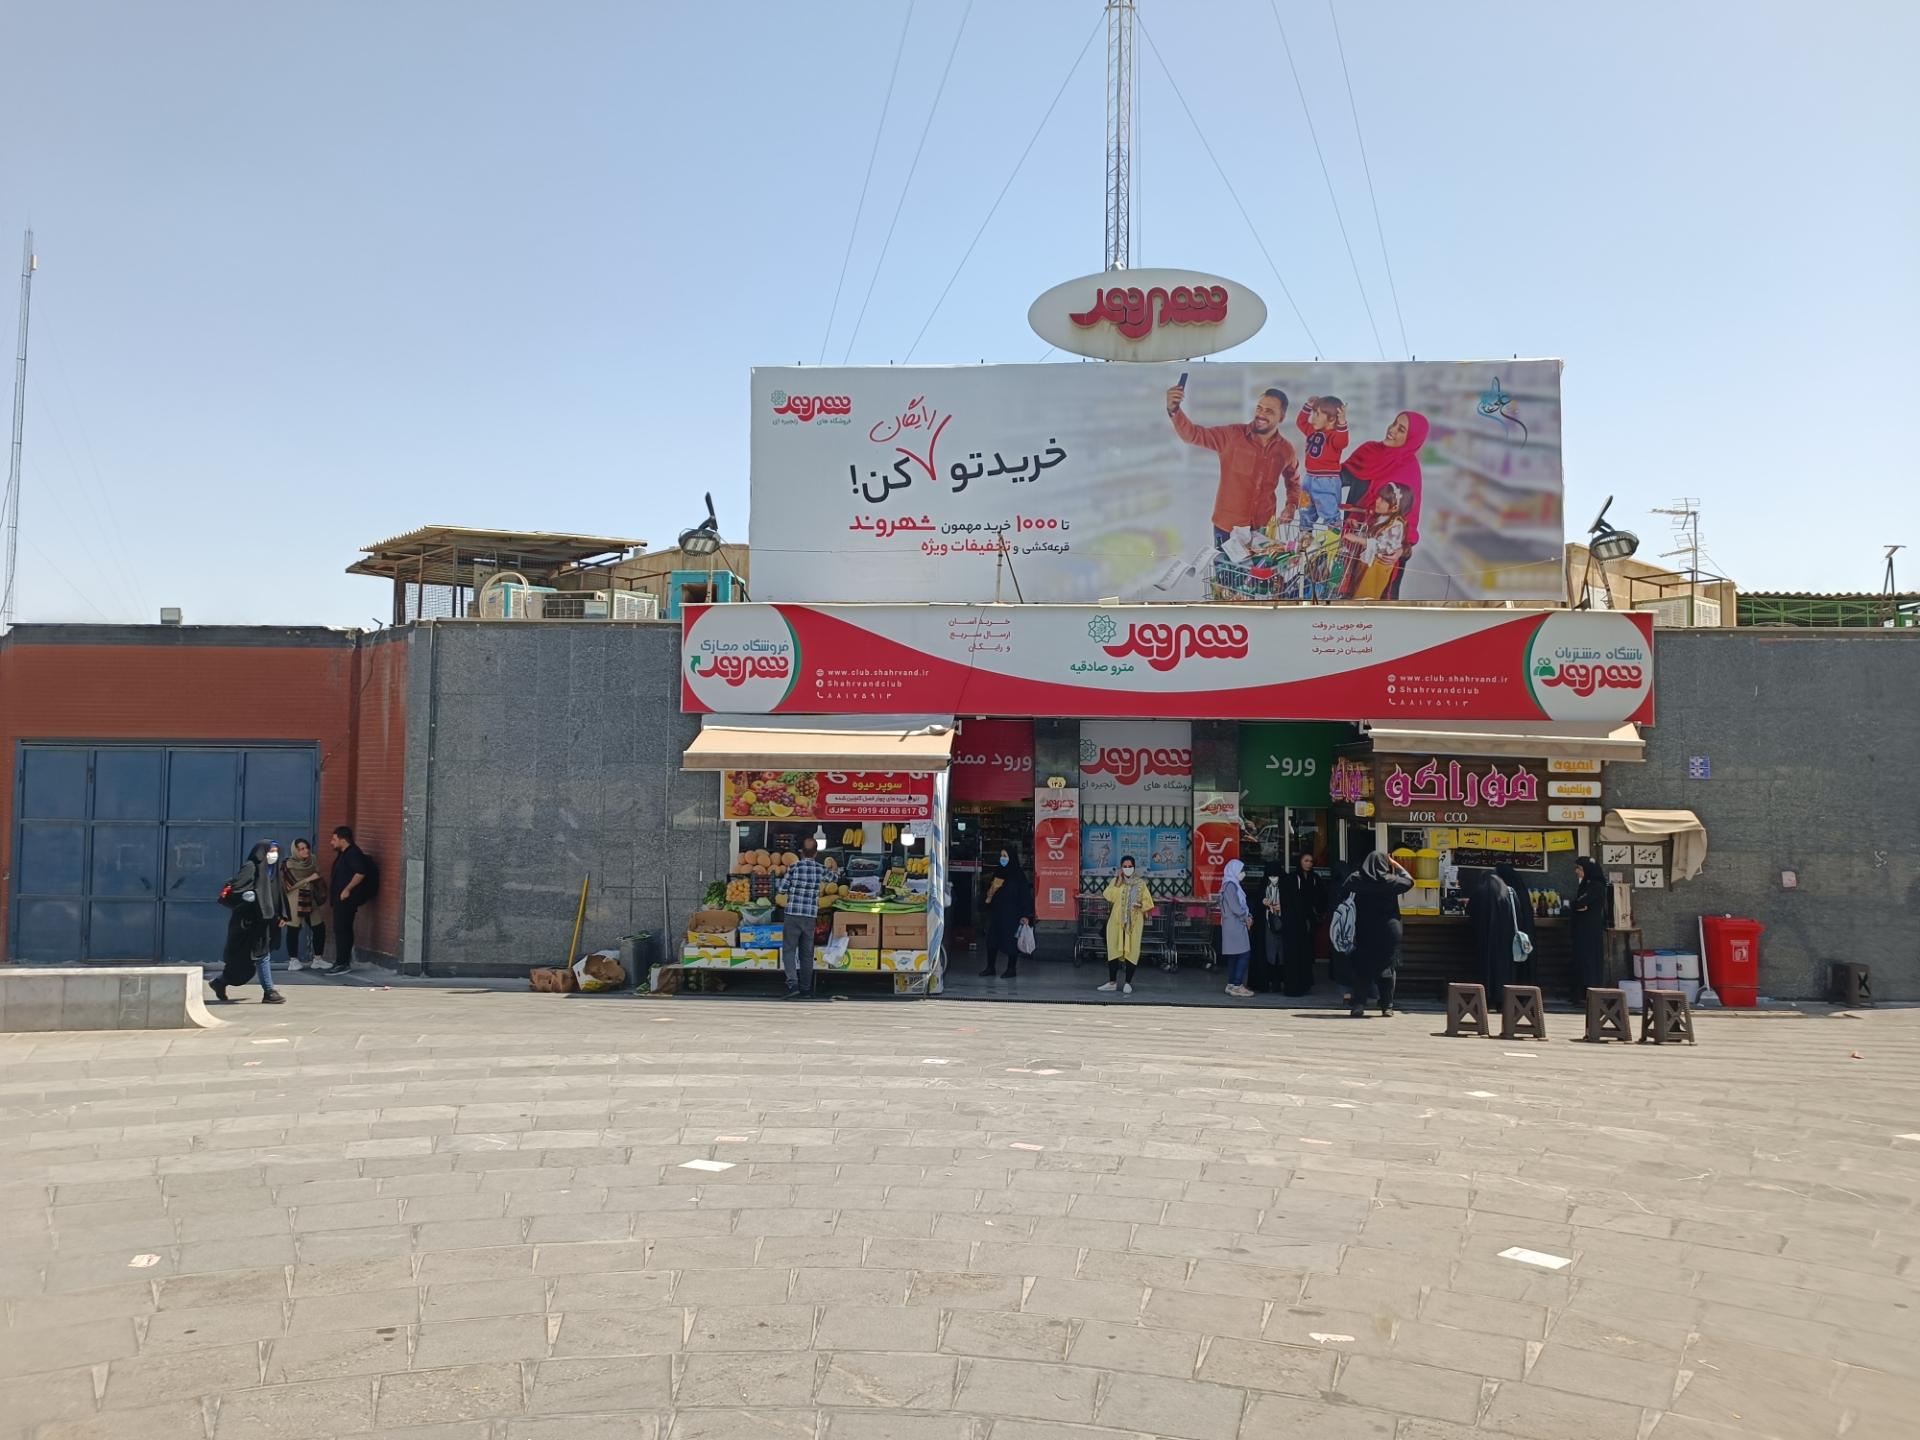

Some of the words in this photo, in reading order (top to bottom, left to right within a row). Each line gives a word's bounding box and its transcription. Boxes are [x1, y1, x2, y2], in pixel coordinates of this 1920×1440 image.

[1069, 285, 1229, 341] شهروند
[849, 514, 936, 537] شهروند
[941, 520, 982, 535] مهمون
[983, 518, 1011, 535] خرید
[1061, 518, 1070, 531] تا
[921, 538, 948, 556] ویژه
[950, 538, 1011, 556] تخفیفات
[1012, 544, 1019, 555] و
[700, 639, 739, 656] مجازی
[742, 639, 789, 656] فروشگاه
[1102, 623, 1249, 672] شهروند
[1555, 647, 1602, 663] مشتریان
[1605, 646, 1643, 664] باشگاه
[697, 655, 789, 687] شهروند
[827, 668, 929, 676] www.club.shahrvand.ir
[1070, 660, 1108, 675] صادقیه
[1110, 663, 1135, 676] مترو
[1400, 674, 1508, 683] www.club.shahrvand.ir
[1541, 664, 1643, 697] شهروند
[953, 750, 987, 765] ممن
[991, 753, 1032, 772] ورود
[1265, 754, 1316, 777] ورود
[852, 780, 875, 791] میوه
[876, 781, 902, 793] سوپر
[1091, 780, 1116, 790] زنجیره
[1143, 780, 1161, 791] های
[1385, 757, 1538, 807] موراکو
[857, 806, 877, 815] 0919
[879, 806, 889, 815] 40
[902, 806, 917, 815] 617
[1561, 807, 1585, 820] ذرت
[1608, 846, 1629, 863] نسکافه
[1638, 869, 1659, 887] چای
